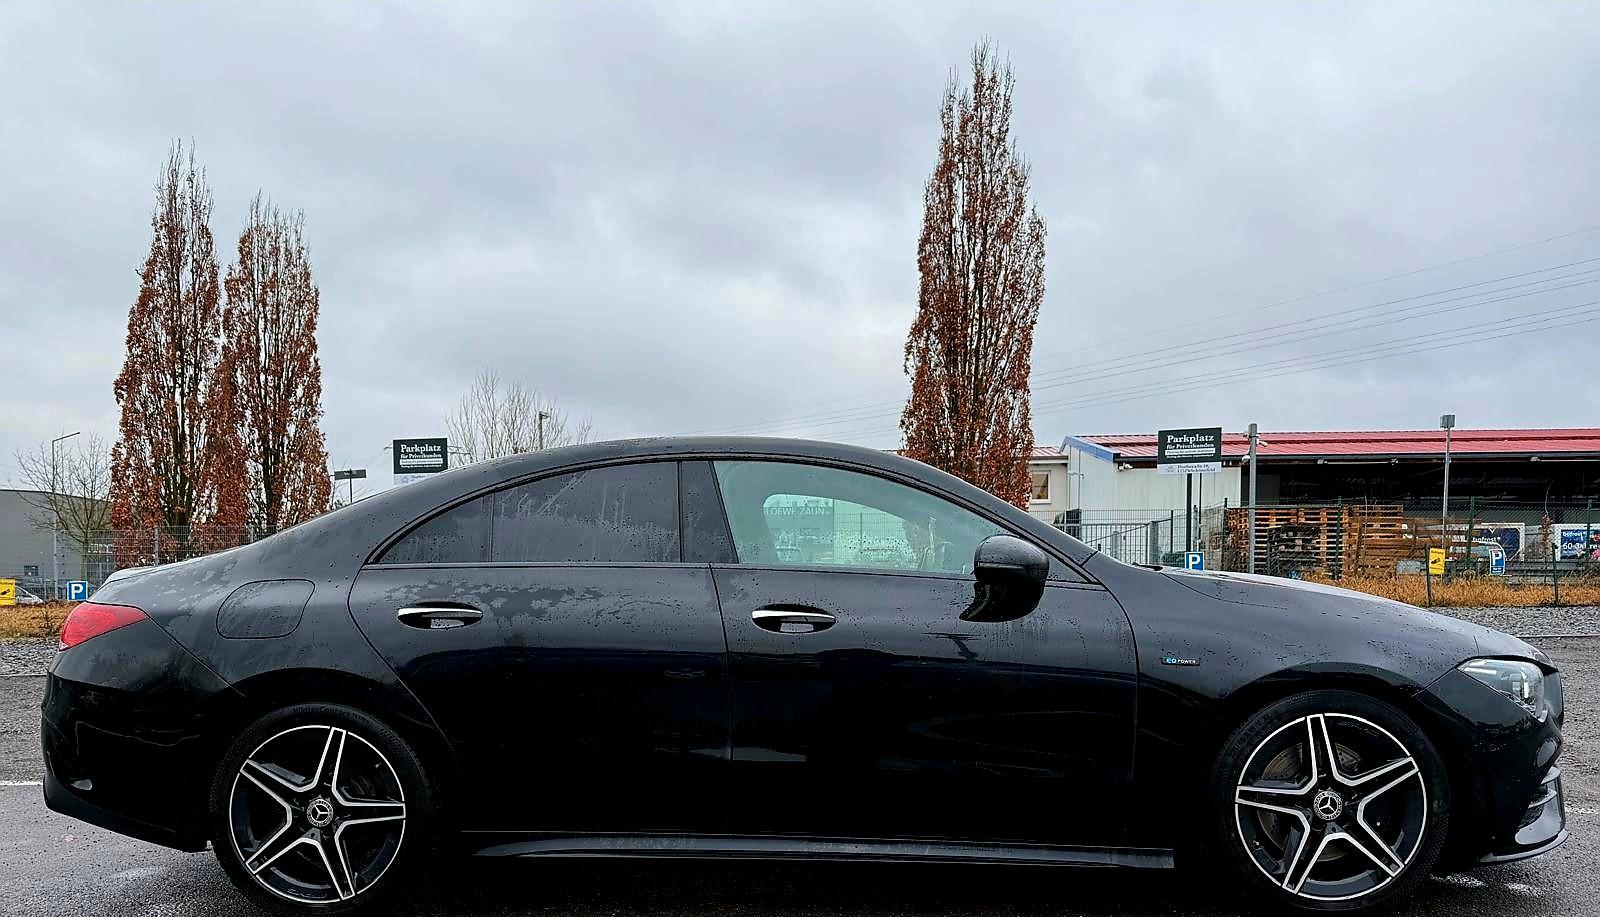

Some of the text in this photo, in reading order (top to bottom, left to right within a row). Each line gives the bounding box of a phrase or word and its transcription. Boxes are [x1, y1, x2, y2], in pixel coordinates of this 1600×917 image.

[1166, 433, 1214, 444] Parkplatz
[400, 443, 441, 454] Parkplatz
[1189, 554, 1200, 570] P
[1492, 550, 1502, 565] P
[71, 583, 84, 600] P
